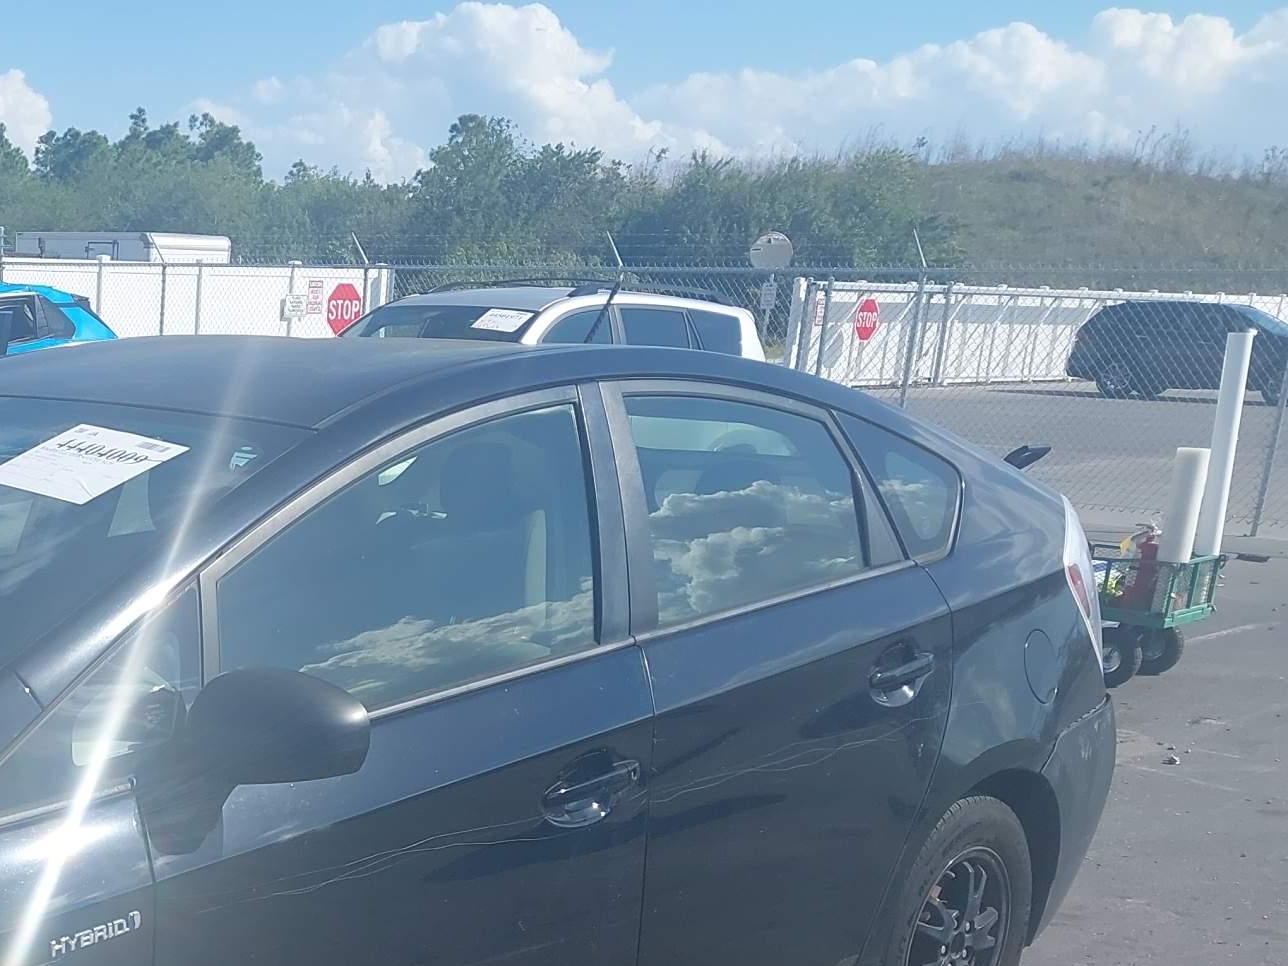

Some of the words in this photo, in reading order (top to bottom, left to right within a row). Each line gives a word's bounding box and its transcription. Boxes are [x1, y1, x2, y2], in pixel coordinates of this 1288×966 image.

[329, 299, 360, 320] STOP
[856, 311, 878, 328] STOP
[56, 438, 149, 465] 44404009
[50, 918, 130, 958] HYBRID
